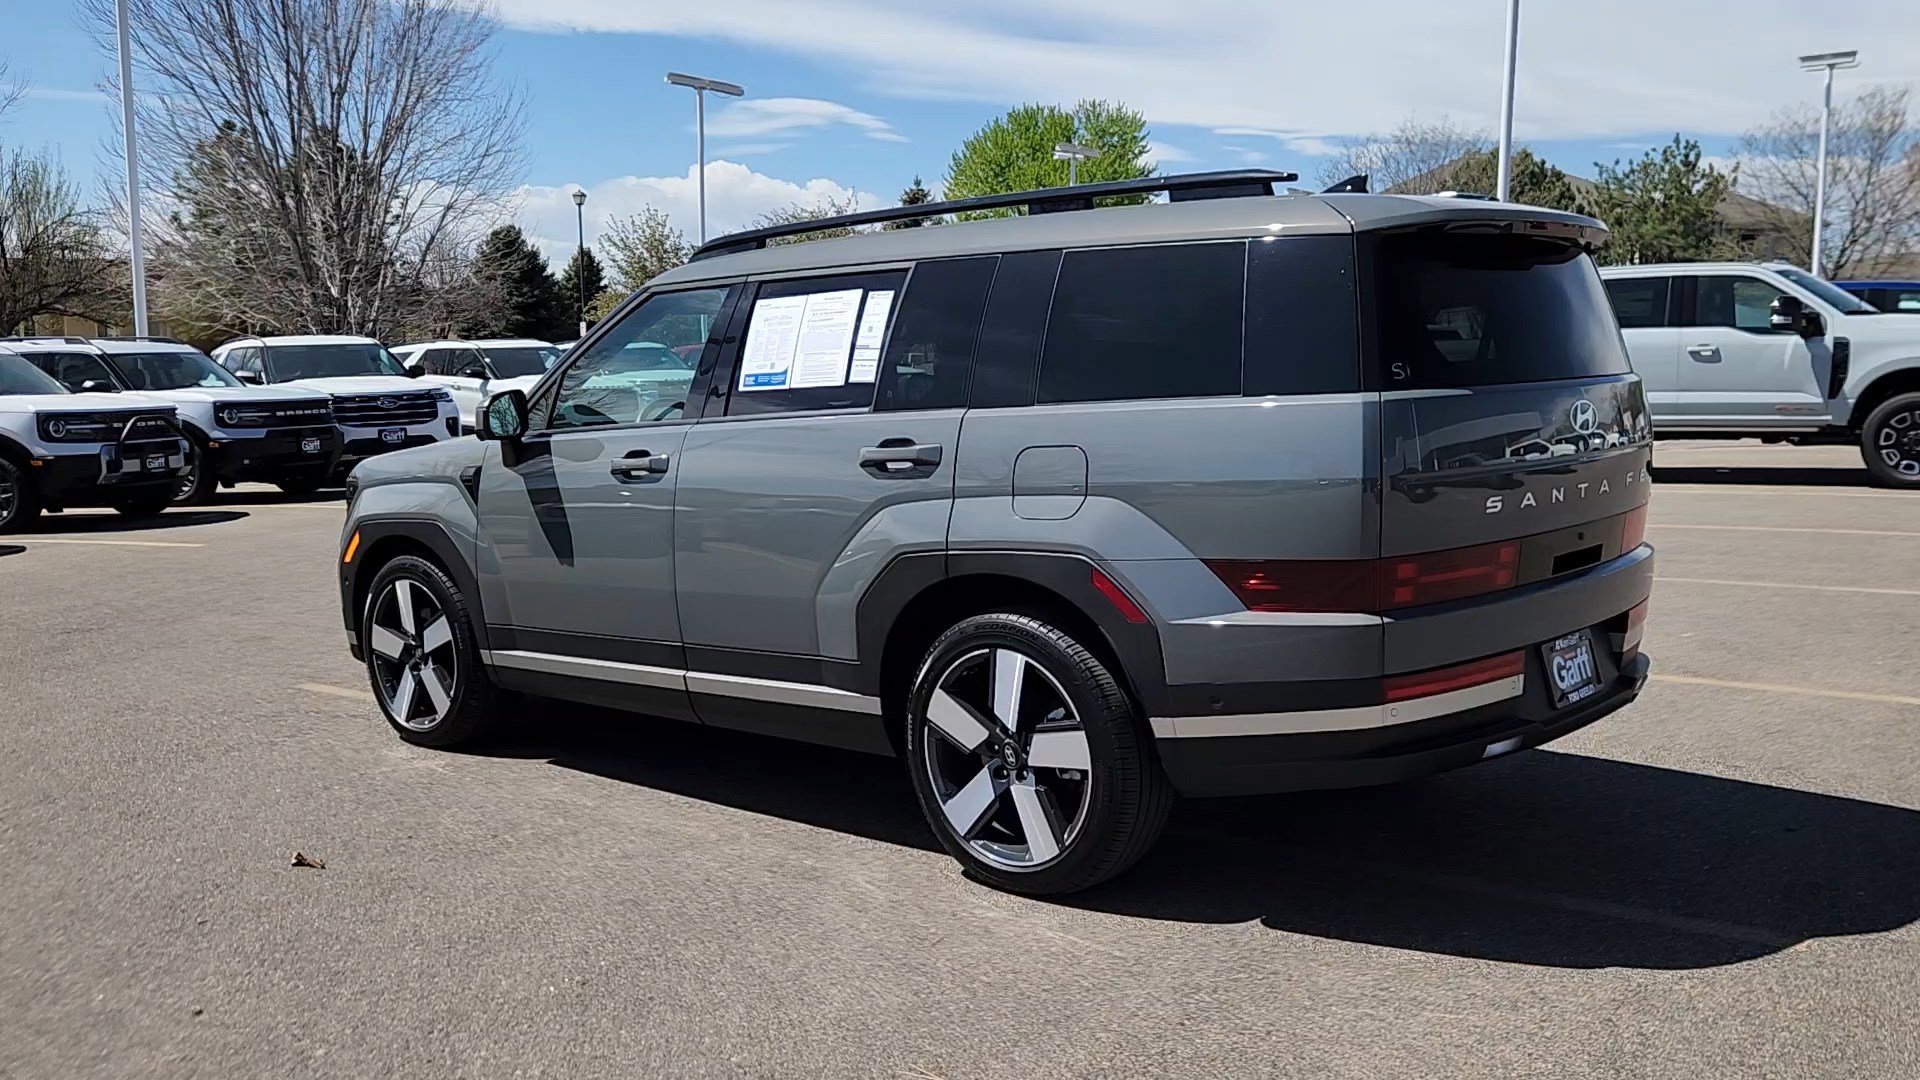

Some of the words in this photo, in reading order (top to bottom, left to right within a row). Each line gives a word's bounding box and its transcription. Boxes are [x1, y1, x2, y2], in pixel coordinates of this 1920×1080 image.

[381, 430, 406, 441] Garff
[301, 440, 321, 451] Garff
[146, 457, 166, 469] Garff
[1485, 478, 1610, 514] SANTA
[1553, 646, 1592, 689] Garff
